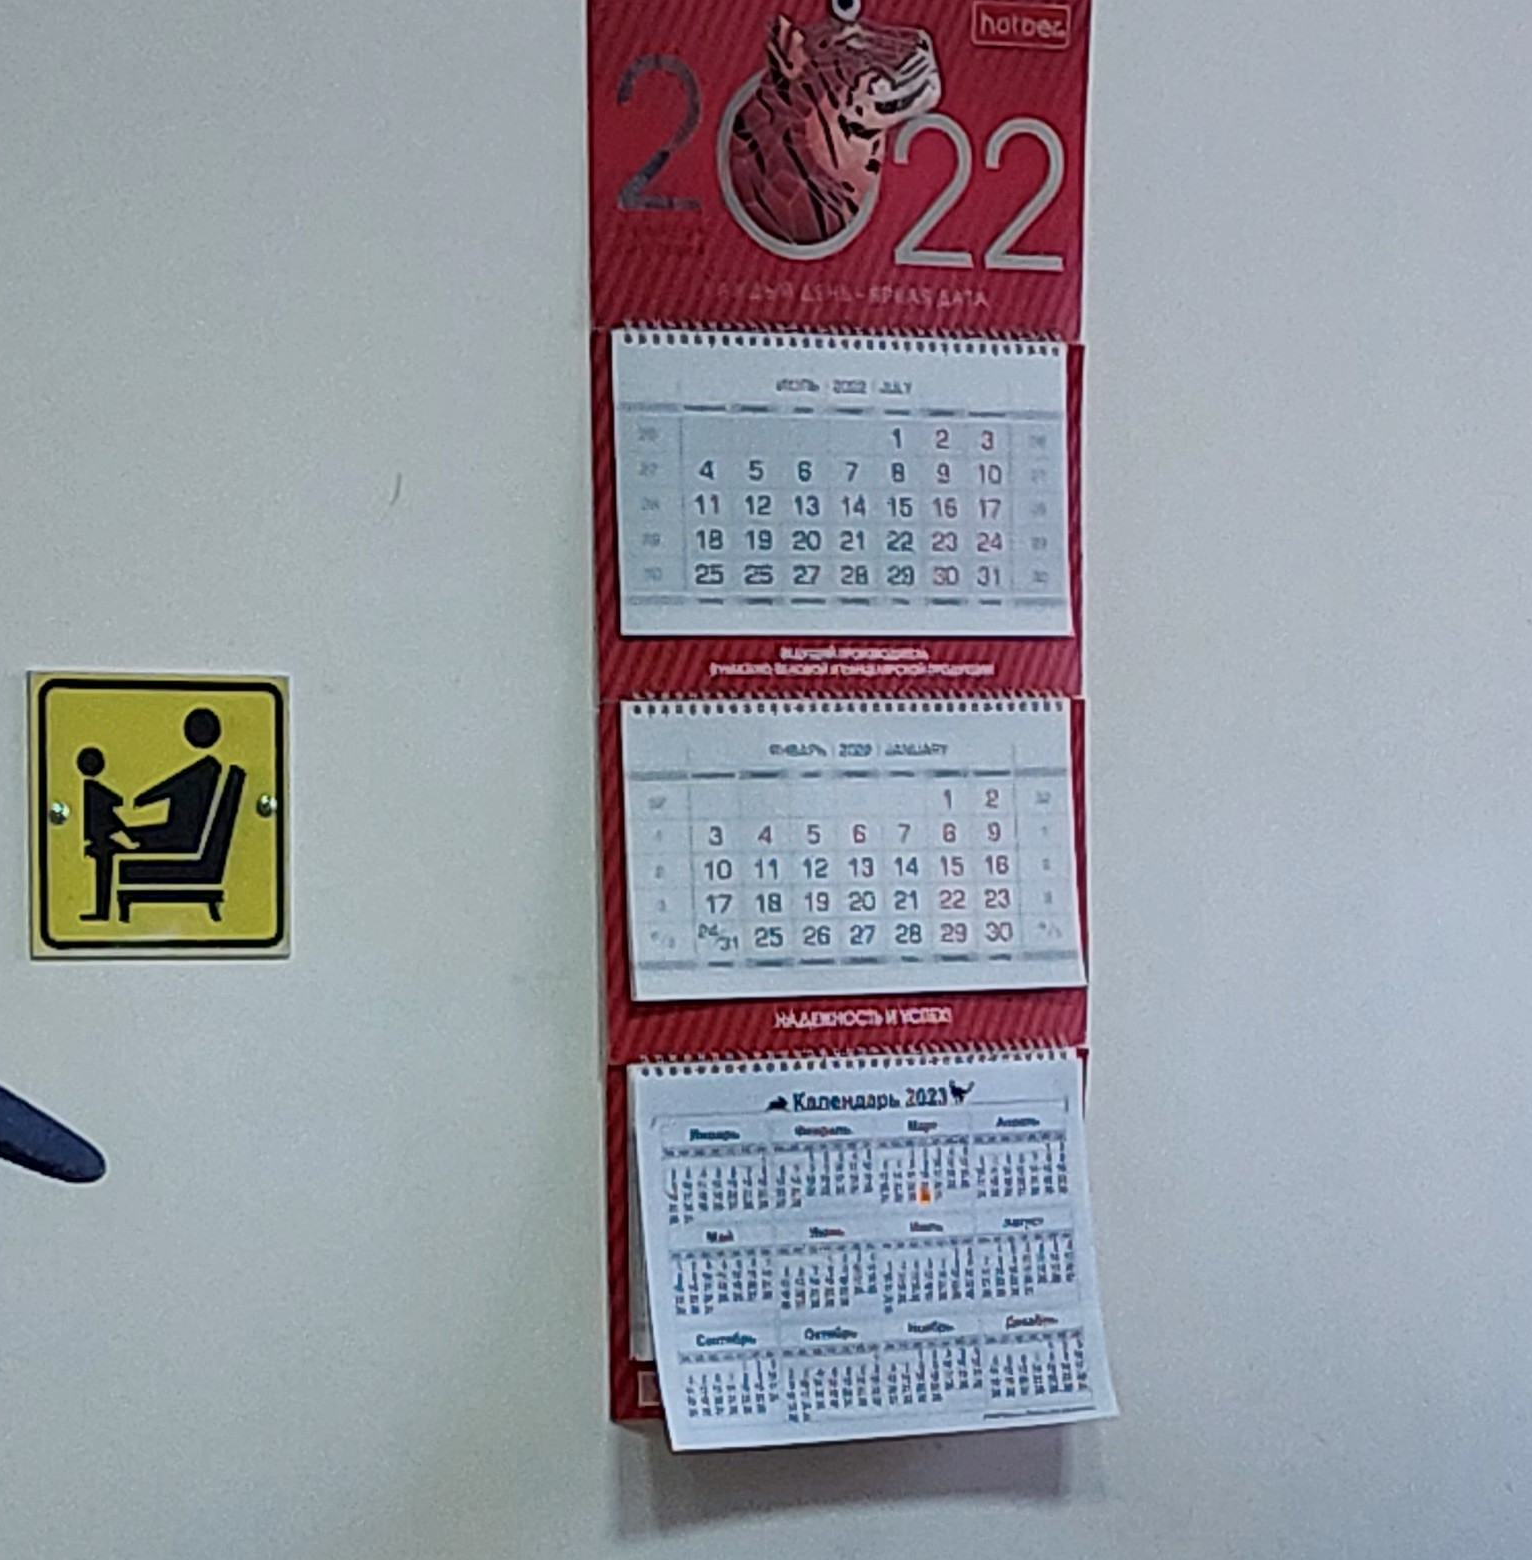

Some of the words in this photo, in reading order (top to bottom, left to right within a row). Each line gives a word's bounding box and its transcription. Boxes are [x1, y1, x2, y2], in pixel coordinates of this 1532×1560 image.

[892, 428, 902, 449] 1
[935, 428, 950, 450] 2
[980, 429, 994, 451] 3
[698, 460, 714, 480] 4
[748, 459, 764, 482] 5
[797, 460, 812, 483] 6
[845, 461, 859, 482] 7
[978, 463, 1003, 485] 10
[694, 494, 719, 515] 11
[745, 494, 772, 516] 12
[794, 494, 820, 517] 13
[841, 494, 866, 517] 14
[887, 496, 913, 518] 15
[932, 497, 958, 519] 16
[979, 498, 1002, 519] 17
[696, 528, 724, 550] 18
[792, 530, 822, 551] 20
[839, 530, 865, 552] 21
[886, 530, 914, 552] 22
[931, 531, 958, 552] 23
[976, 531, 1003, 553] 24
[695, 563, 724, 585] 25
[792, 564, 821, 585] 27
[841, 564, 869, 585] 28
[887, 565, 915, 586] 29
[932, 565, 960, 586] 30
[943, 788, 952, 809] 1
[984, 788, 999, 809] 2
[708, 825, 724, 846] 3
[757, 825, 772, 844] 4
[807, 823, 821, 845] 5
[852, 823, 867, 844] 6
[897, 822, 911, 844] 7
[704, 858, 733, 881] 10
[754, 858, 778, 880] 11
[802, 857, 829, 879] 12
[848, 856, 874, 878] 13
[894, 856, 919, 877] 14
[940, 855, 965, 877] 15
[706, 893, 733, 914] 17
[847, 890, 876, 912] 20
[893, 889, 918, 911] 21
[939, 889, 966, 910] 22
[984, 888, 1011, 909] 23
[754, 926, 784, 948] 25
[802, 925, 831, 947] 26
[849, 924, 876, 946] 27
[895, 923, 923, 945] 28
[940, 922, 968, 944] 29
[985, 921, 1014, 943] 30
[792, 1091, 901, 1113] Календарь
[904, 1086, 948, 1108] 2023
